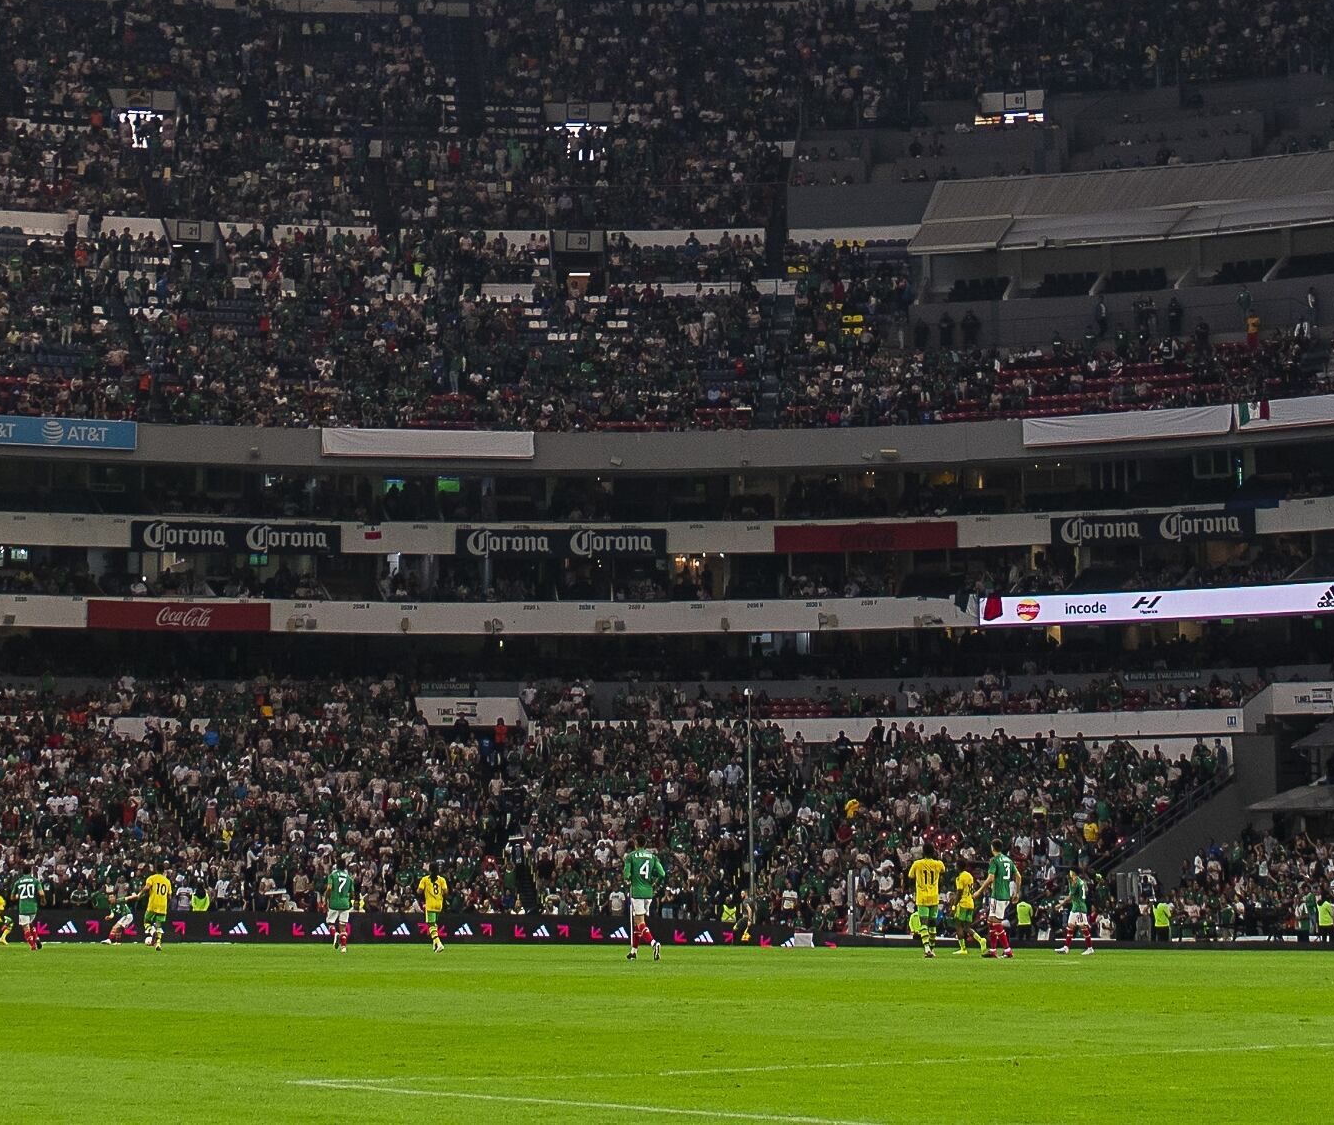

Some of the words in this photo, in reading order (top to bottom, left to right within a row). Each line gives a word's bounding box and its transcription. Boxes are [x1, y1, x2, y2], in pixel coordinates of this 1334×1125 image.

[189, 227, 197, 236] 21
[67, 426, 109, 443] AT&T
[1060, 518, 1140, 546] Corona
[1159, 513, 1240, 542] Corona
[143, 523, 226, 551] Corona
[246, 524, 328, 553] Corona
[467, 530, 549, 558] Corona
[570, 530, 653, 558] Corona
[1065, 601, 1107, 615] incode
[1294, 695, 1312, 704] TUNEL
[437, 708, 455, 716] TUNEL
[639, 860, 650, 879] 4
[923, 870, 934, 885] 11
[1003, 862, 1011, 880] 3
[18, 883, 35, 899] 20
[157, 882, 167, 896] 10
[339, 877, 347, 893] 7
[432, 883, 439, 896] 8
